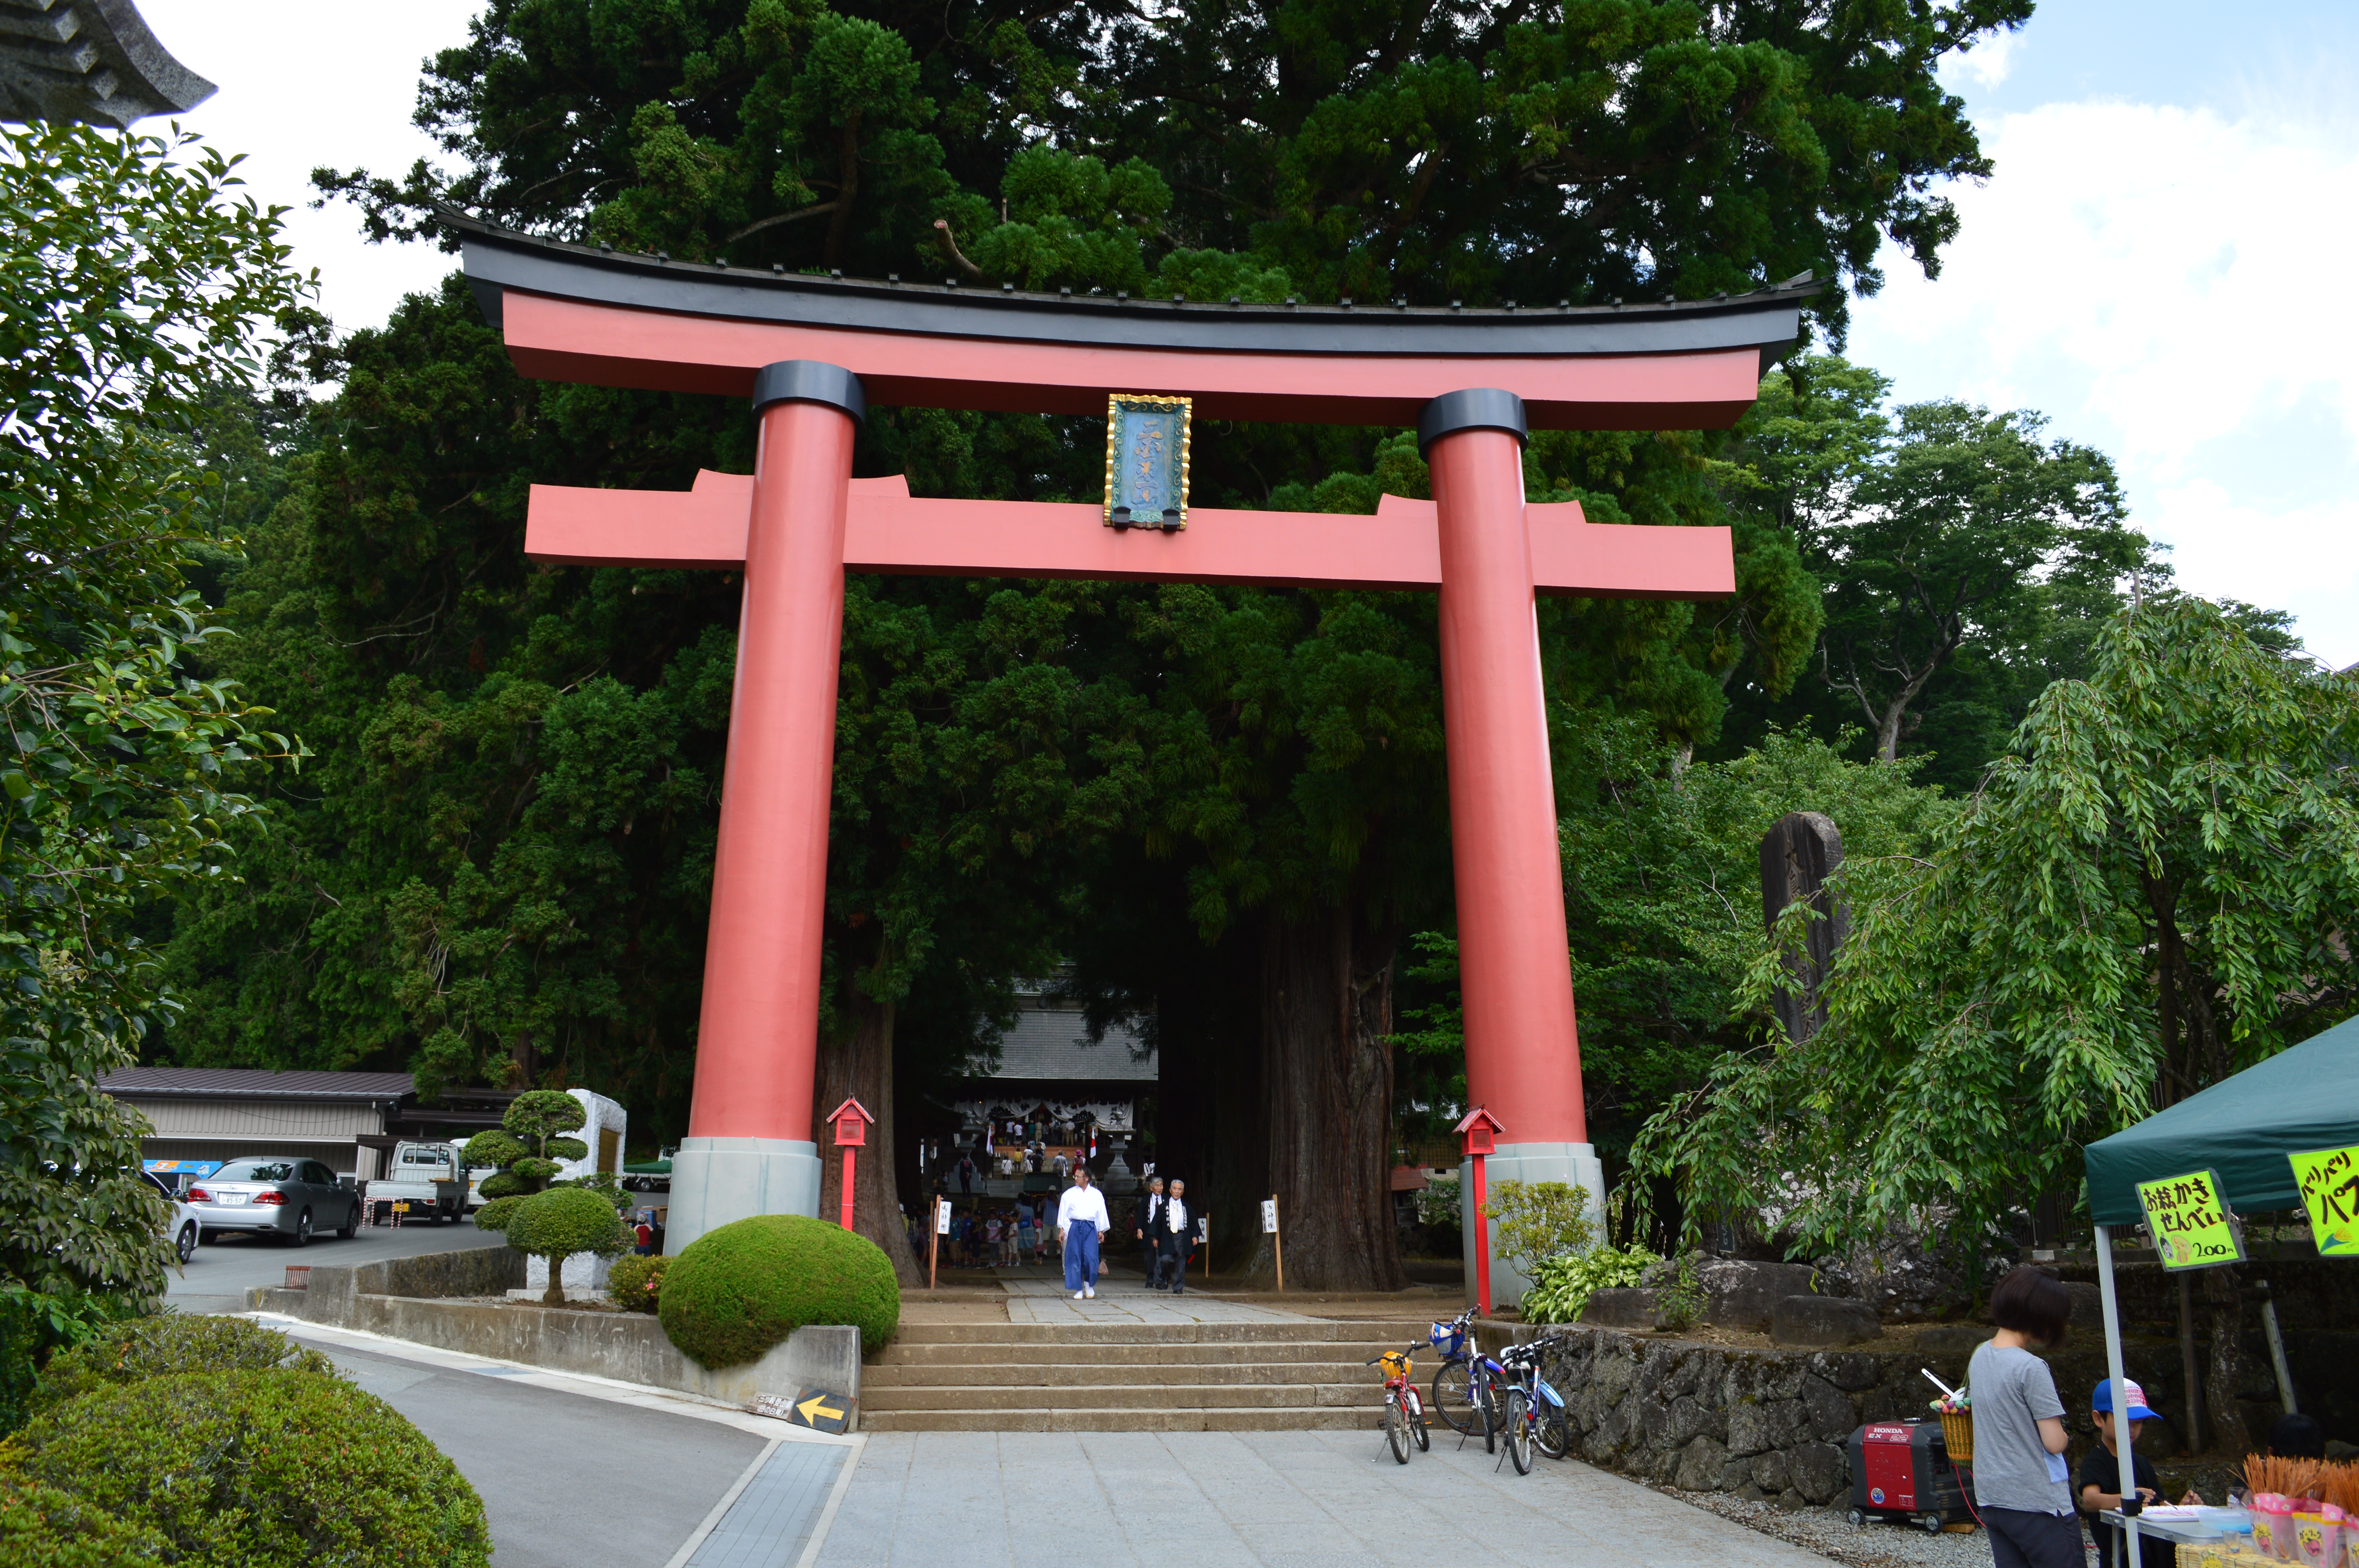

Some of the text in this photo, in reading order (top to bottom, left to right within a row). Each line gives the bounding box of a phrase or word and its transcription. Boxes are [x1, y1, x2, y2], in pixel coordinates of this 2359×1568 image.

[2301, 1151, 2351, 1203] パリパリ
[2143, 1178, 2211, 1212] お絵かき
[2160, 1207, 2225, 1232] せんべい
